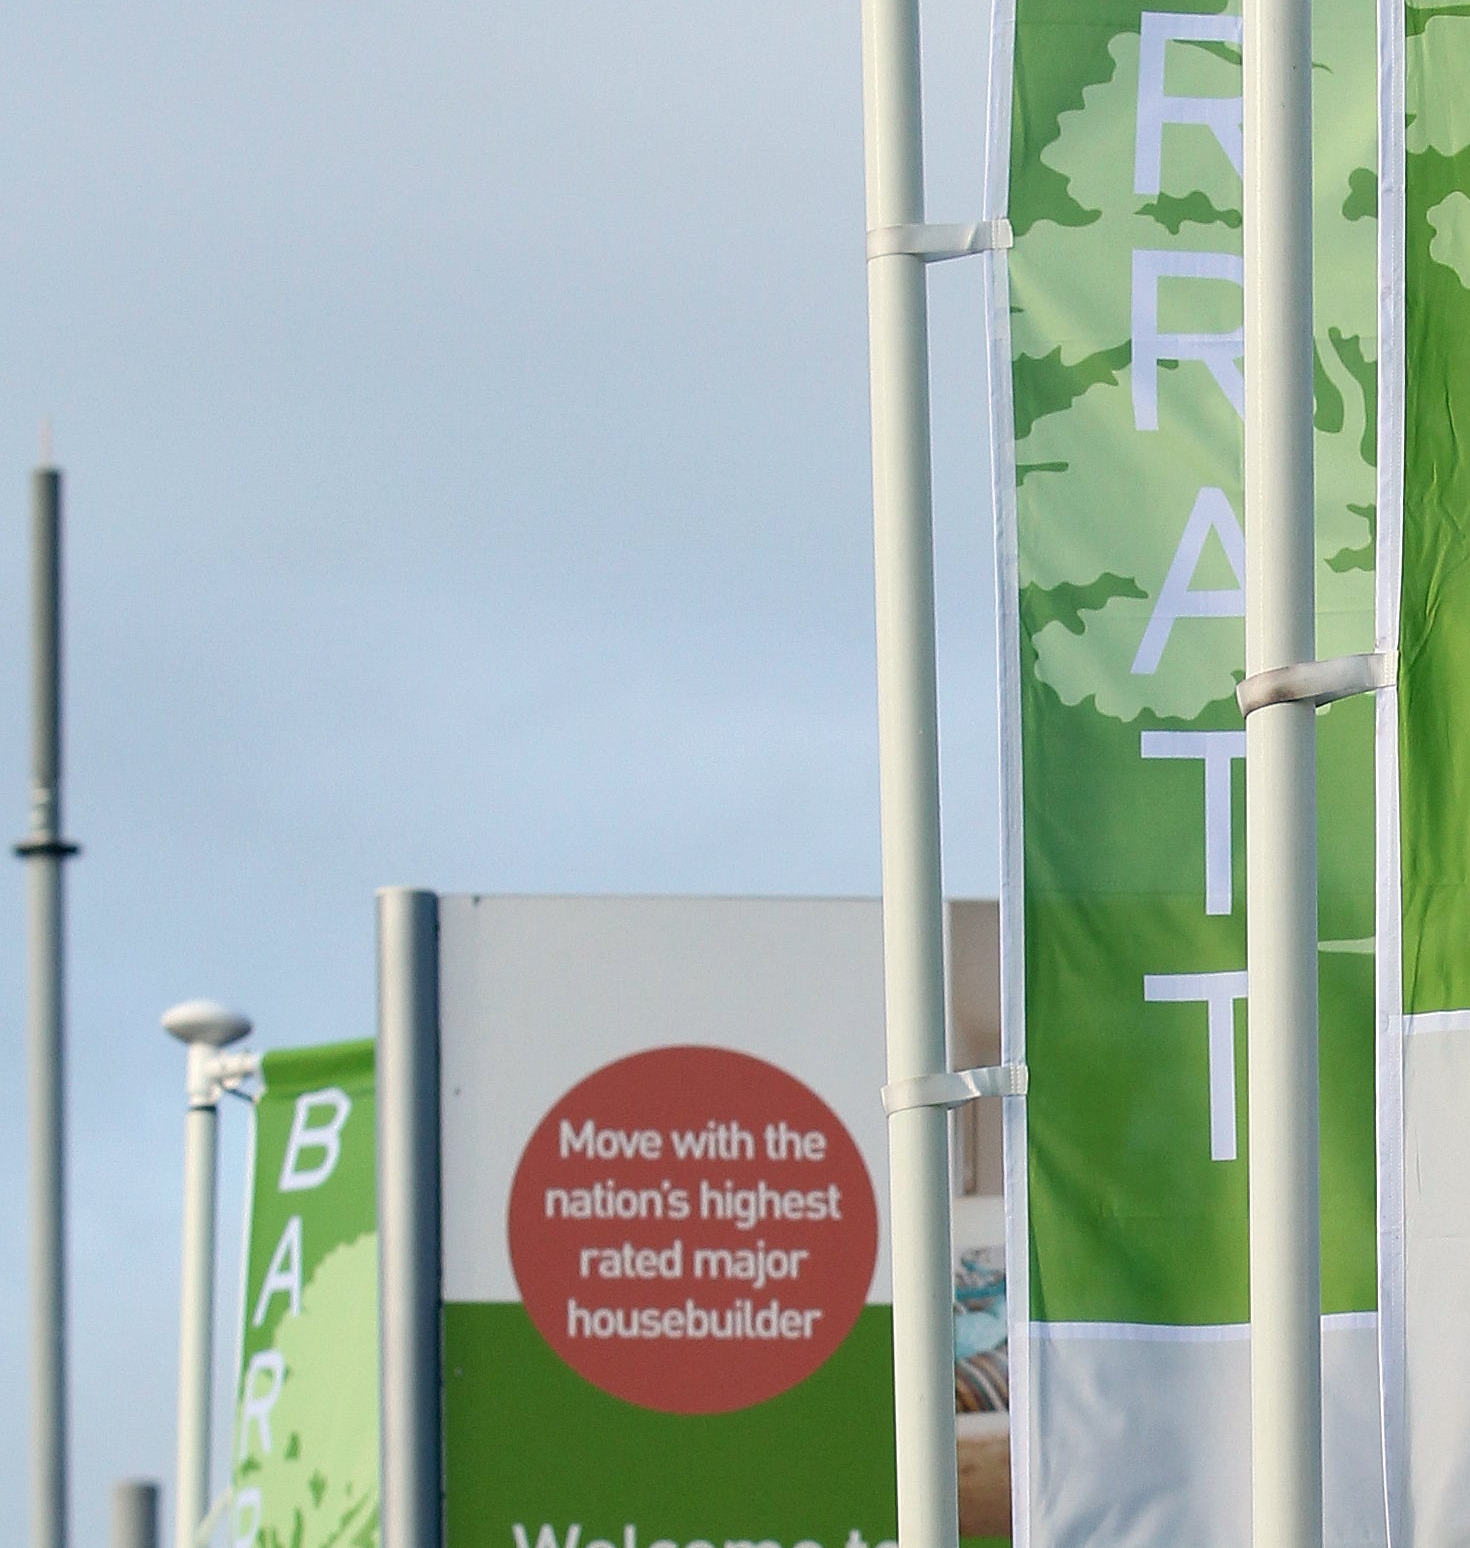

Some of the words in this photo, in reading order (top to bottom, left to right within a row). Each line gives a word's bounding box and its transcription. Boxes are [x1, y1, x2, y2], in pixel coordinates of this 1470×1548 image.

[559, 1119, 662, 1159] Move
[671, 1120, 753, 1159] with
[764, 1121, 827, 1160] the
[545, 1180, 690, 1218] nation's
[699, 1180, 842, 1229] highest
[579, 1240, 683, 1278] rated
[693, 1240, 808, 1289] major
[567, 1298, 822, 1339] housebuilder
